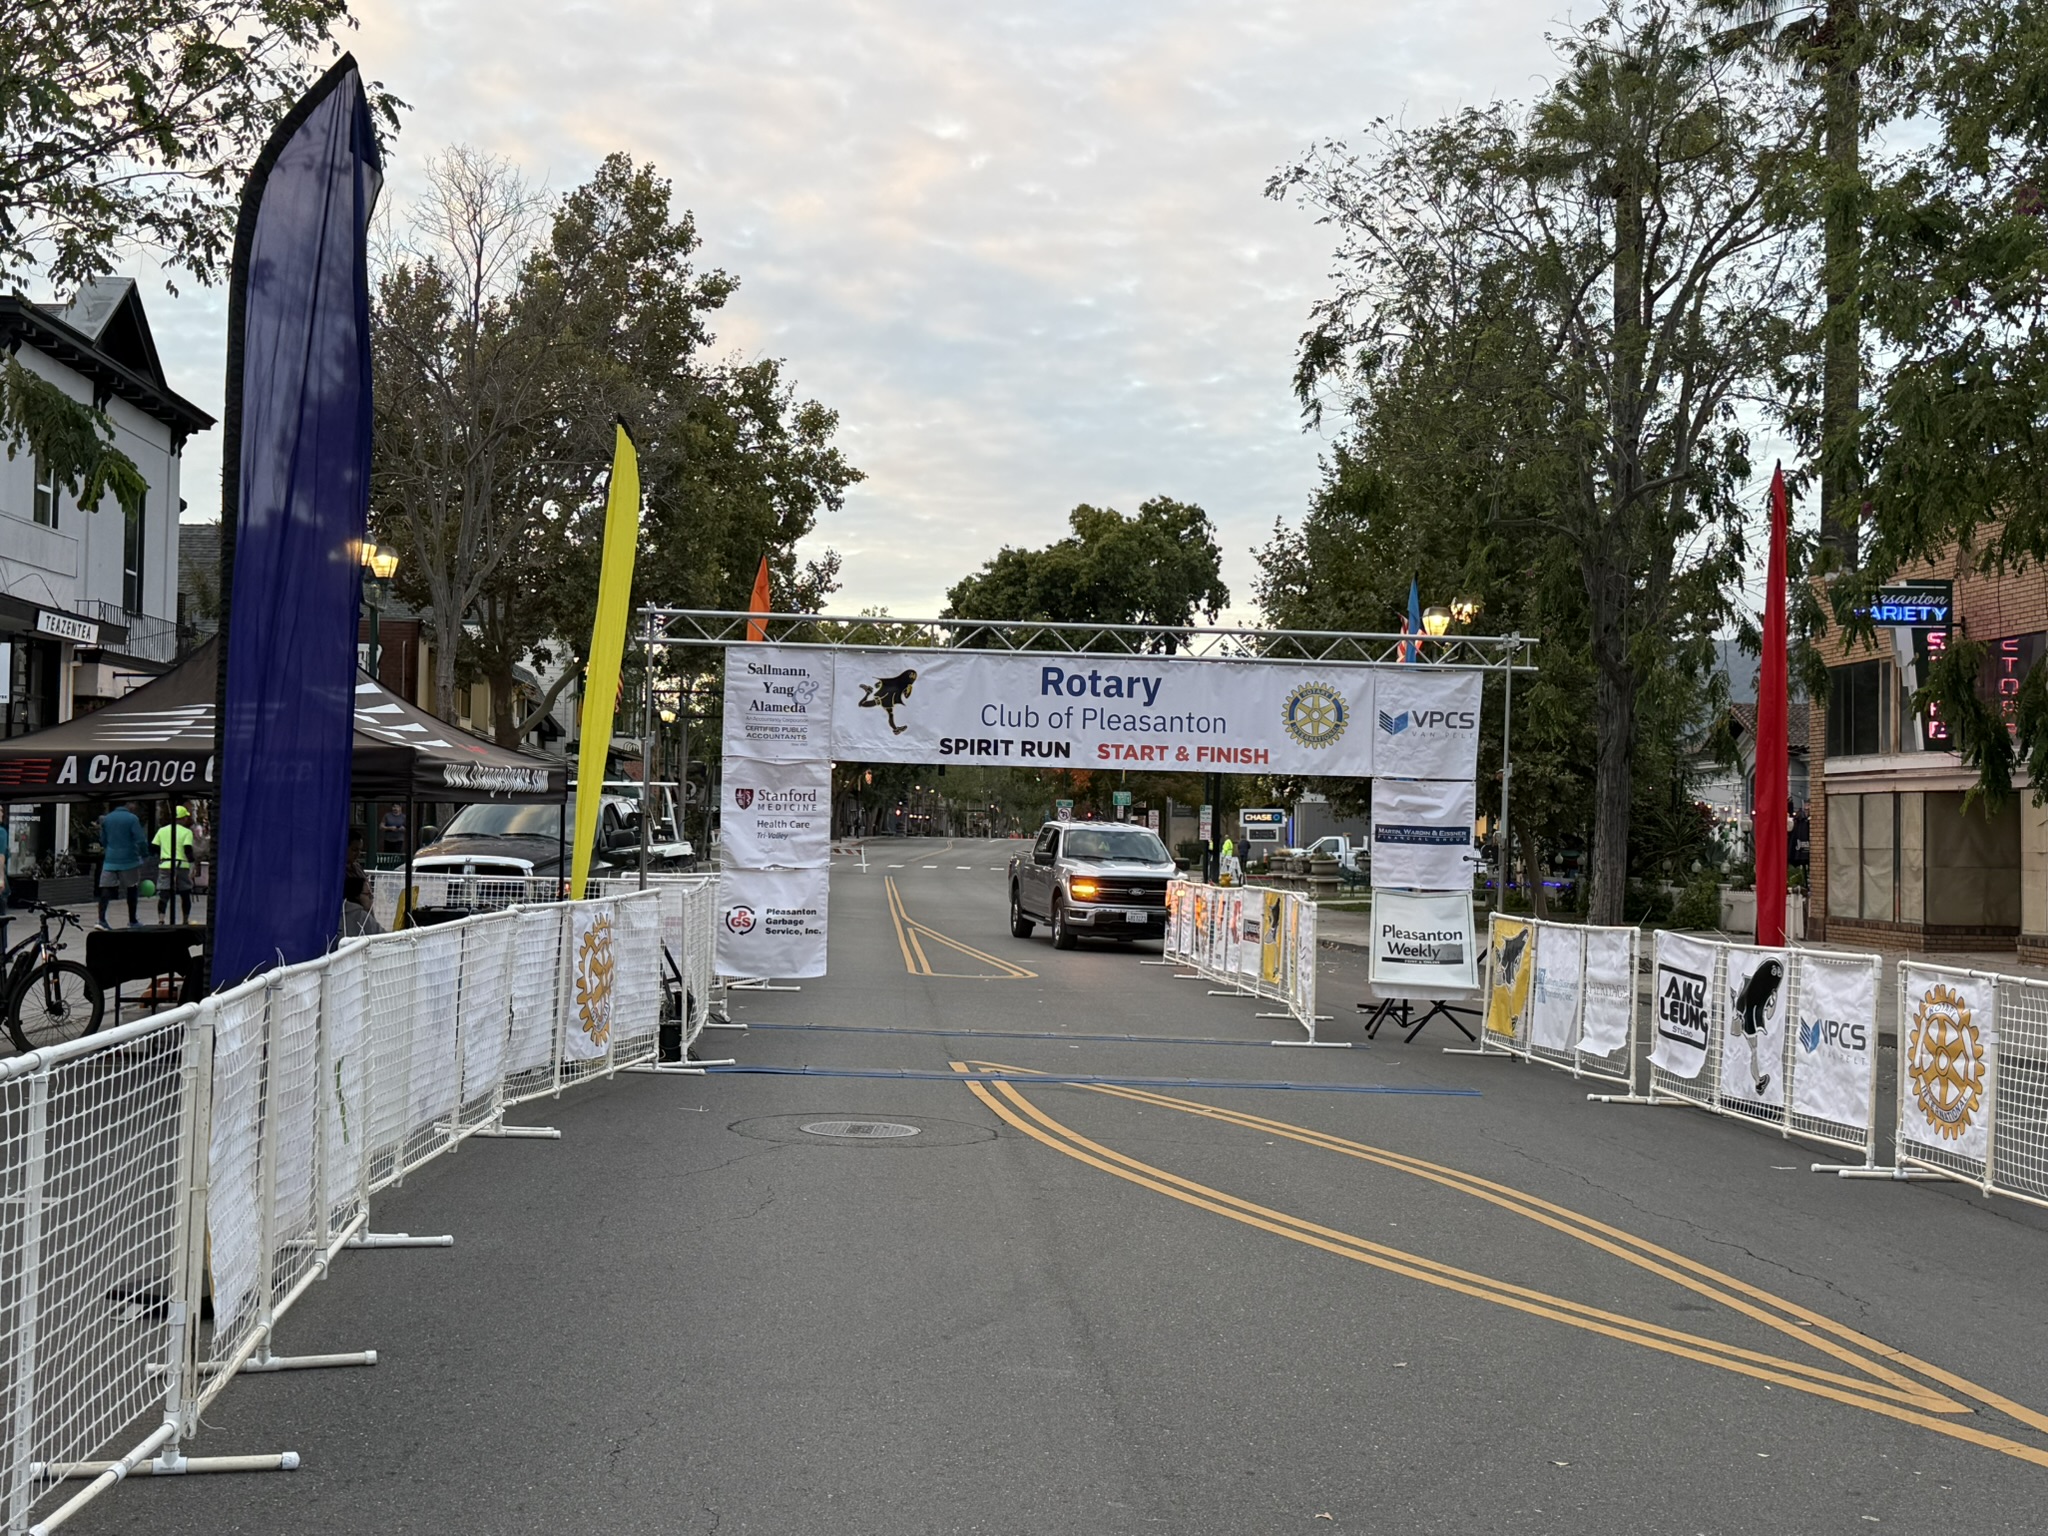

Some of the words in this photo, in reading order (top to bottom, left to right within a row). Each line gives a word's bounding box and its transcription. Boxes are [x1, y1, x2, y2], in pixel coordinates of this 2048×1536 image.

[1853, 606, 1947, 621] ARIETY
[45, 615, 91, 641] TEAZENTEA
[747, 662, 810, 678] Sallmann,
[763, 681, 794, 697] Yang
[792, 681, 819, 705] &
[1041, 666, 1162, 707] Rotary
[749, 700, 806, 713] Alameda
[981, 704, 1039, 728] Club
[1048, 706, 1074, 729] of
[1082, 707, 1226, 734] Pleasanton
[1412, 710, 1474, 729] VPCS
[745, 725, 780, 733] CERTIFIED
[746, 732, 807, 740] ACCOUNTANTS
[939, 737, 1014, 757] SPIRIT
[1021, 741, 1071, 758] RUN
[1097, 743, 1169, 761] START
[1175, 745, 1190, 761] &
[1197, 746, 1269, 764] FINISH
[57, 755, 78, 784] A
[88, 754, 196, 787] Change
[758, 788, 816, 802] Stanford
[757, 803, 817, 812] MEDICINE
[757, 820, 787, 829] Health
[790, 820, 810, 829] Care
[1403, 828, 1430, 836] WARDIN
[756, 832, 788, 841] Tri-Valley
[766, 908, 817, 916] Pleasanton
[731, 916, 751, 928] GS
[766, 918, 804, 926] Garbage
[765, 927, 802, 936] Service,
[805, 927, 822, 935] Inc.
[1382, 924, 1463, 941] Pleasanton
[1387, 941, 1441, 961] Weekly
[1664, 976, 1706, 1008] AMY
[1660, 996, 1709, 1033] LEUNG
[1928, 1002, 1957, 1018] ROTARY
[1672, 1025, 1693, 1038] STUDIO
[1820, 1019, 1866, 1051] VPCS
[1921, 1085, 1968, 1120] INTERNATIONAL
